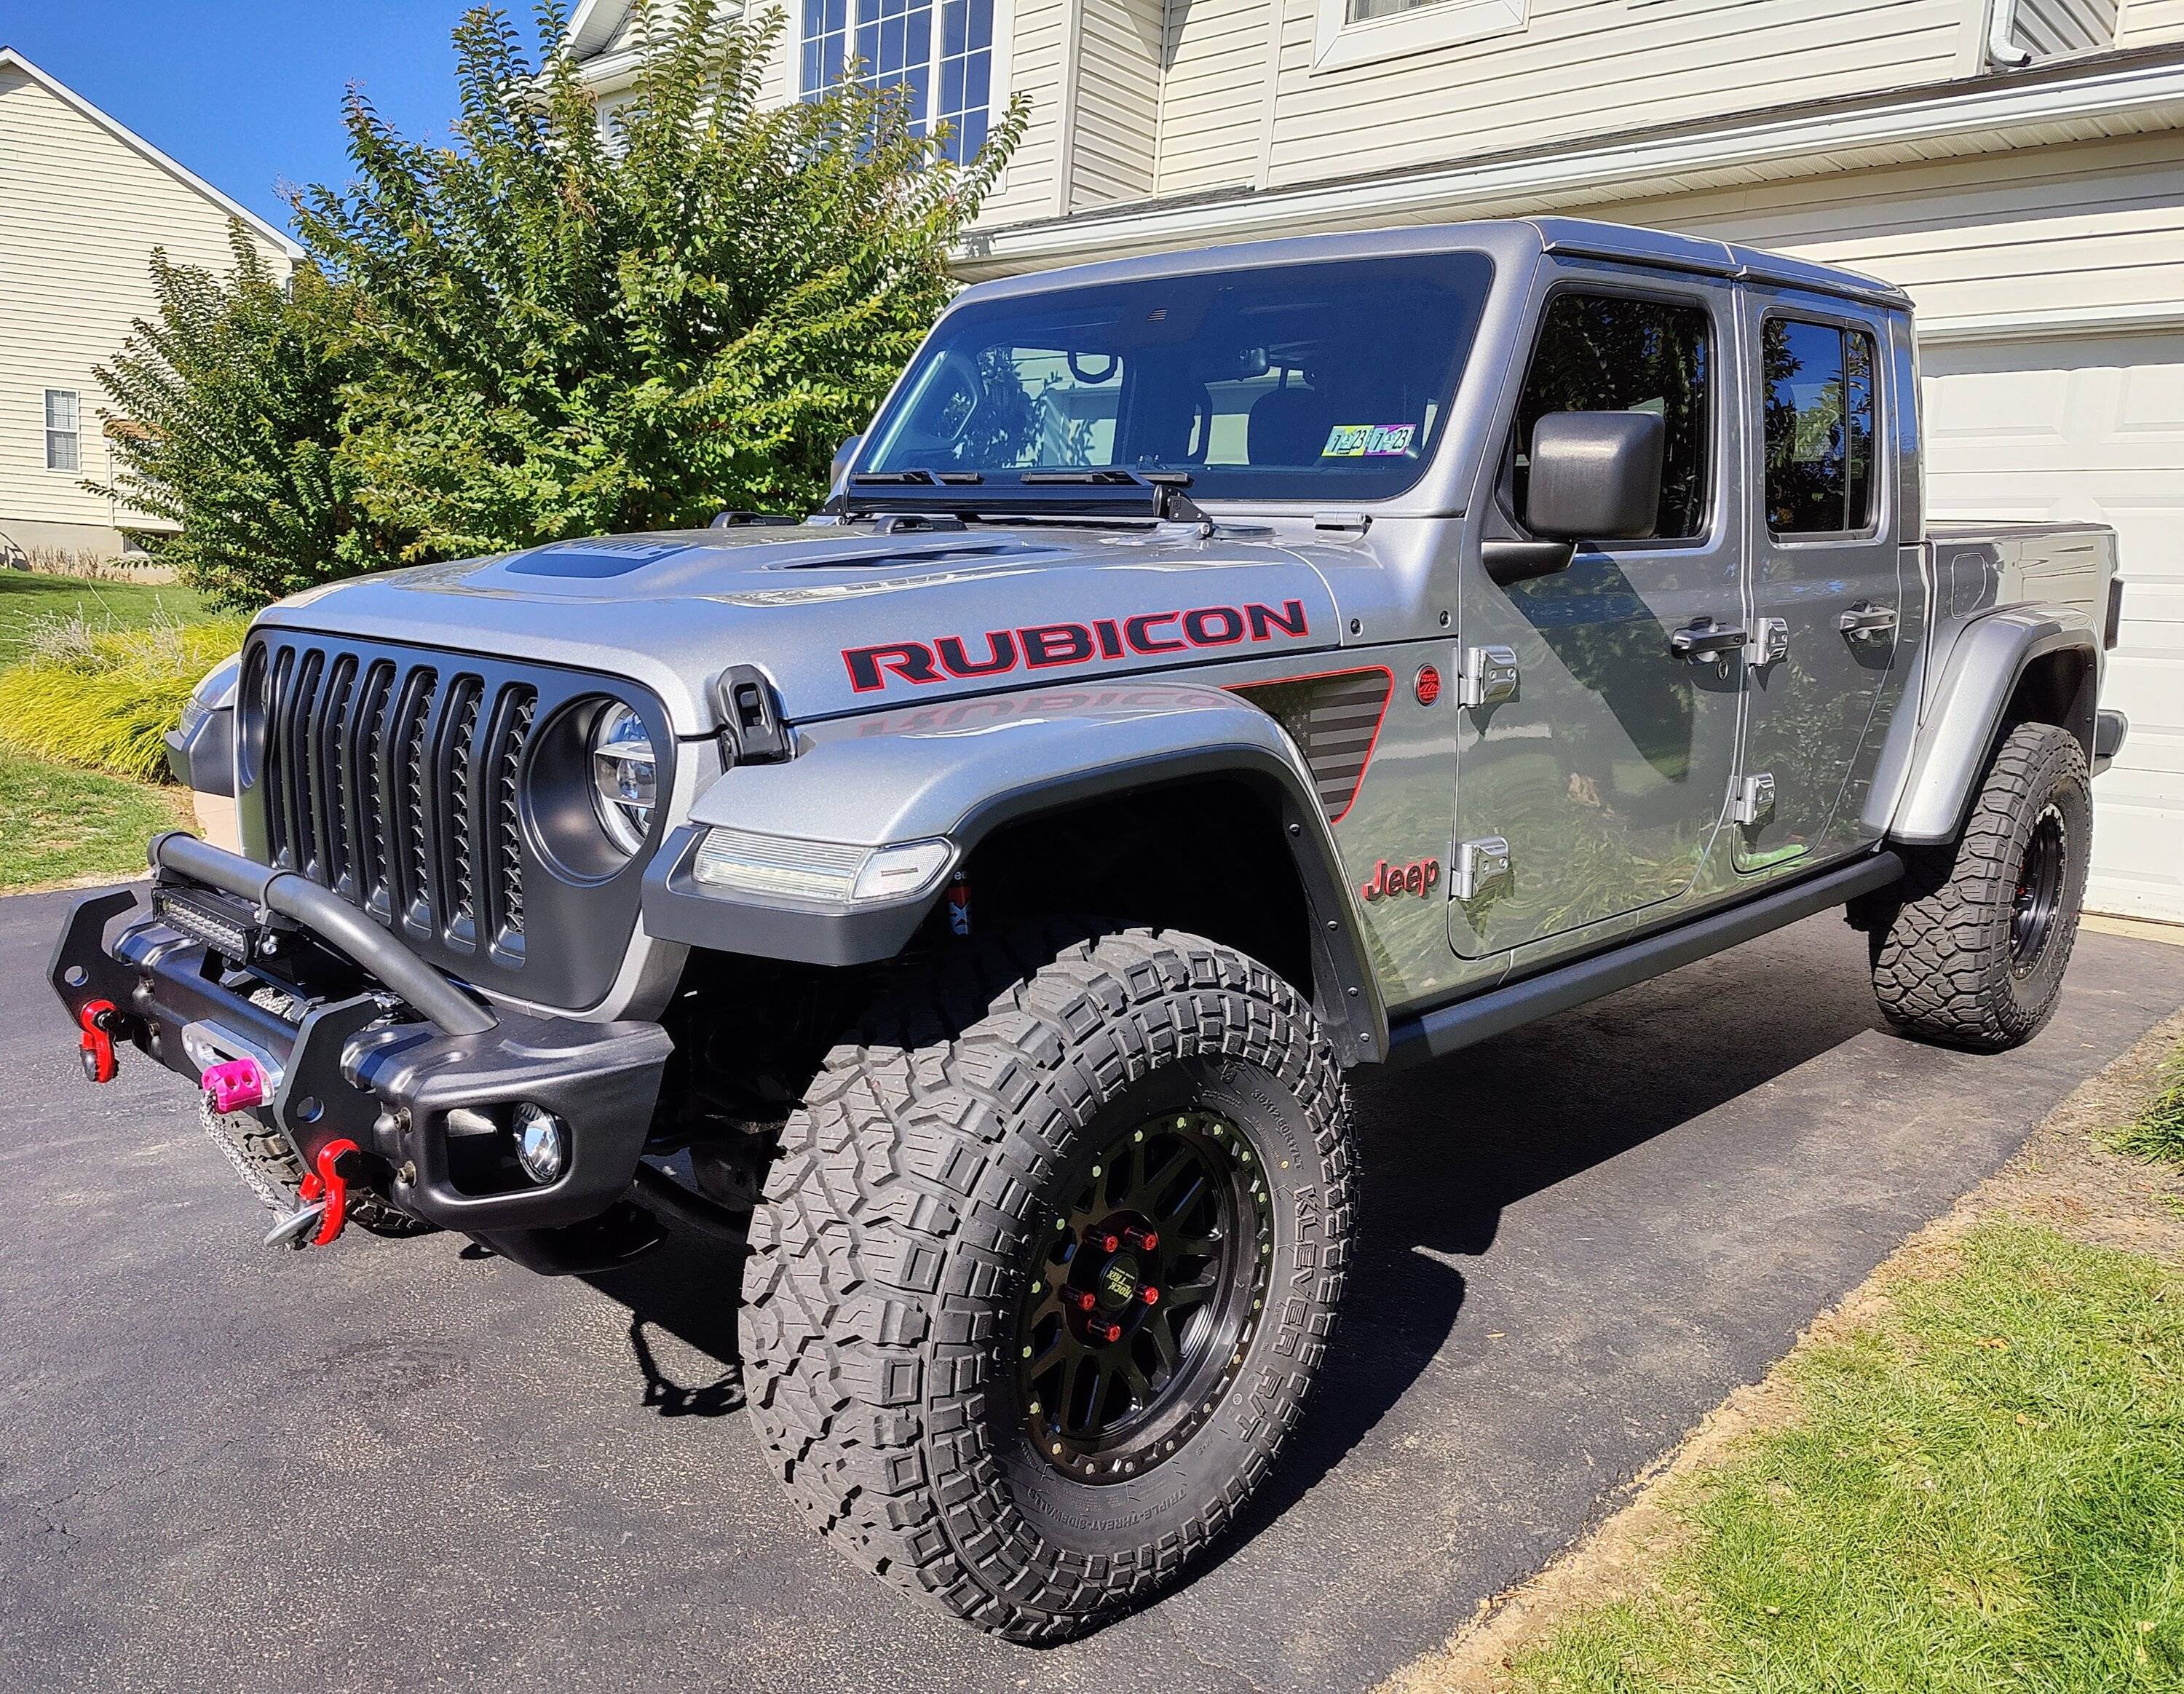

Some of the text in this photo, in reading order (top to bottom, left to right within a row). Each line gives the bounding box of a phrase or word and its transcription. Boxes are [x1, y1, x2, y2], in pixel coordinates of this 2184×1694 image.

[1331, 430, 1366, 453] 7 23
[1374, 430, 1408, 451] 7 23
[841, 599, 1309, 693] RUBICON
[1362, 857, 1441, 902] Jeep
[1273, 1184, 1316, 1358] KLEVER
[1107, 1281, 1132, 1298] ROCK
